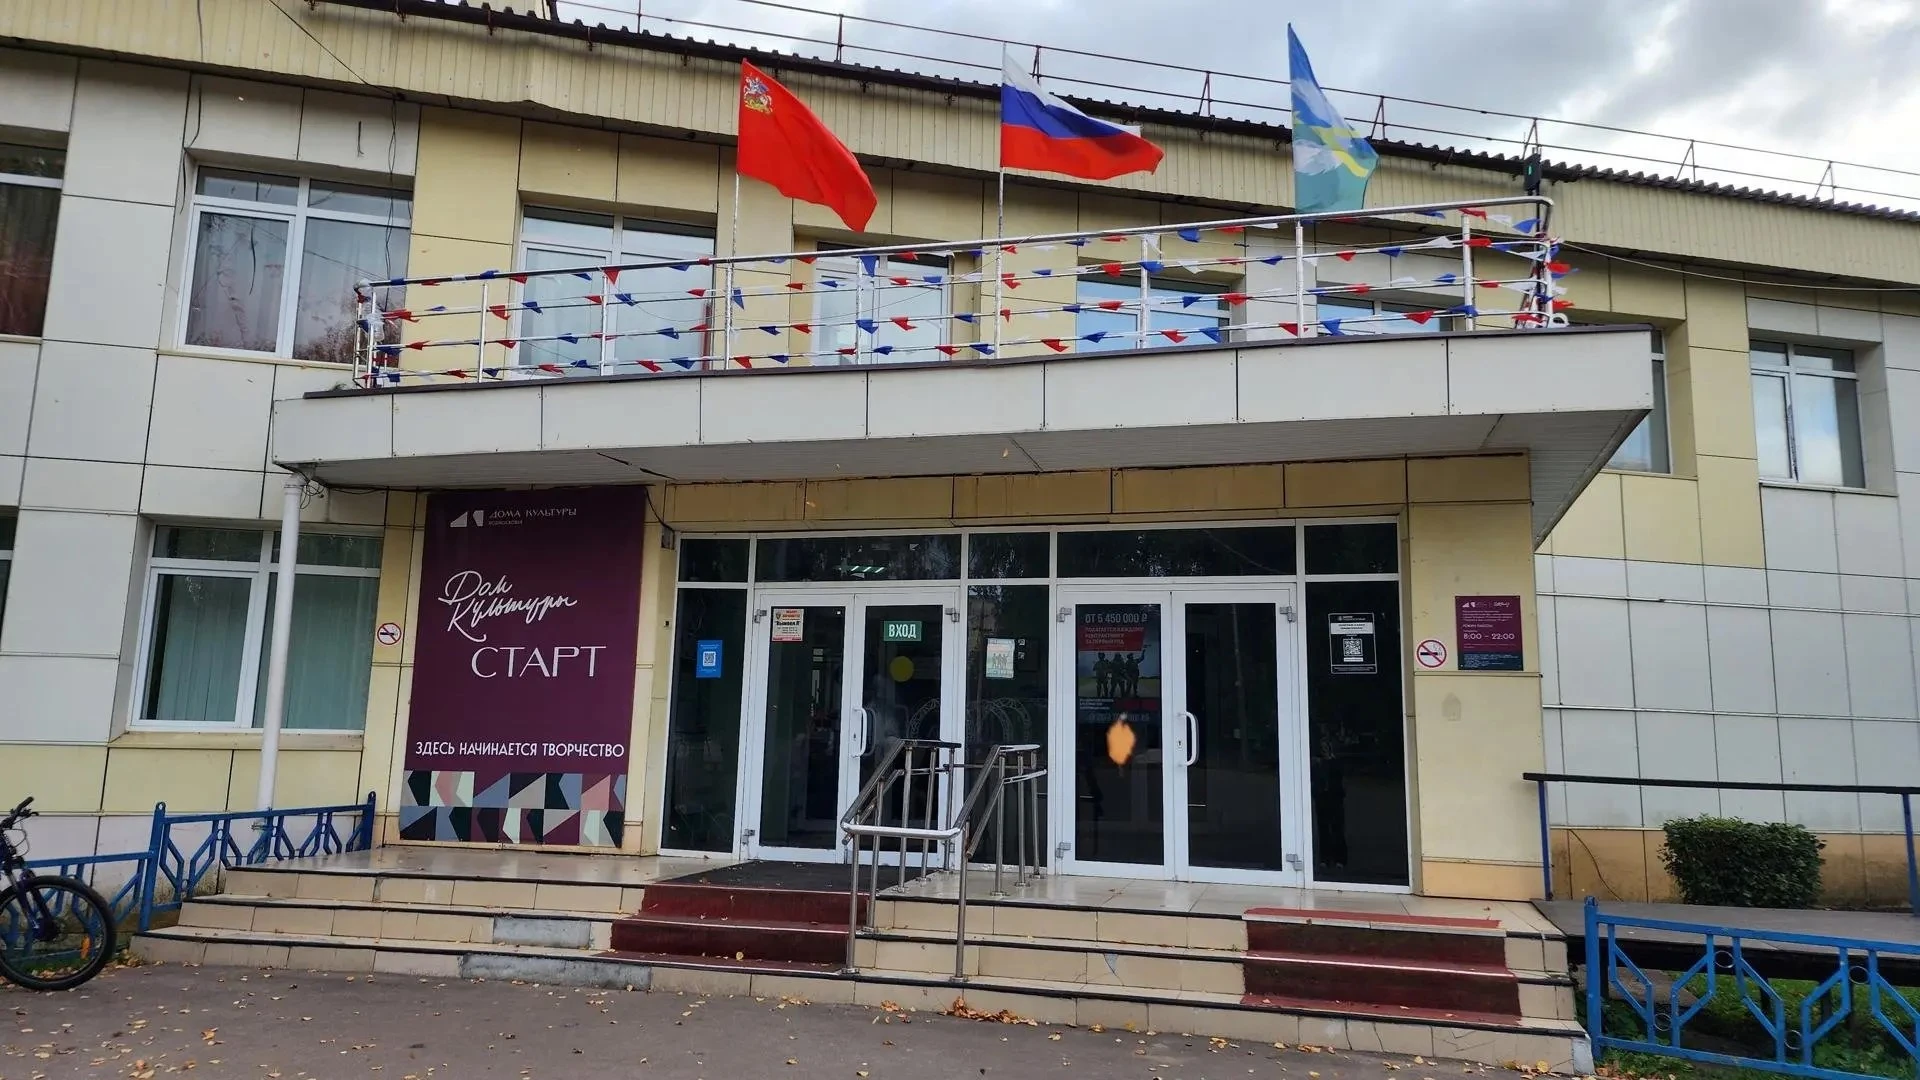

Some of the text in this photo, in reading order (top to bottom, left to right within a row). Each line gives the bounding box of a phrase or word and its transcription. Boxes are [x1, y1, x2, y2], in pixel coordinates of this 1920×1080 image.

[489, 507, 577, 518] ДОМА КУЛЬТУРЫ
[1085, 613, 1096, 623] ОТ
[1104, 613, 1121, 623] 450
[1122, 613, 1139, 623] 000
[888, 623, 917, 639] ВХОД
[471, 646, 607, 678] СТАРТ
[415, 741, 625, 758] ЗДЕСЬ НАЧИНАЕТСЯ ТВОРЧЕСТВО
